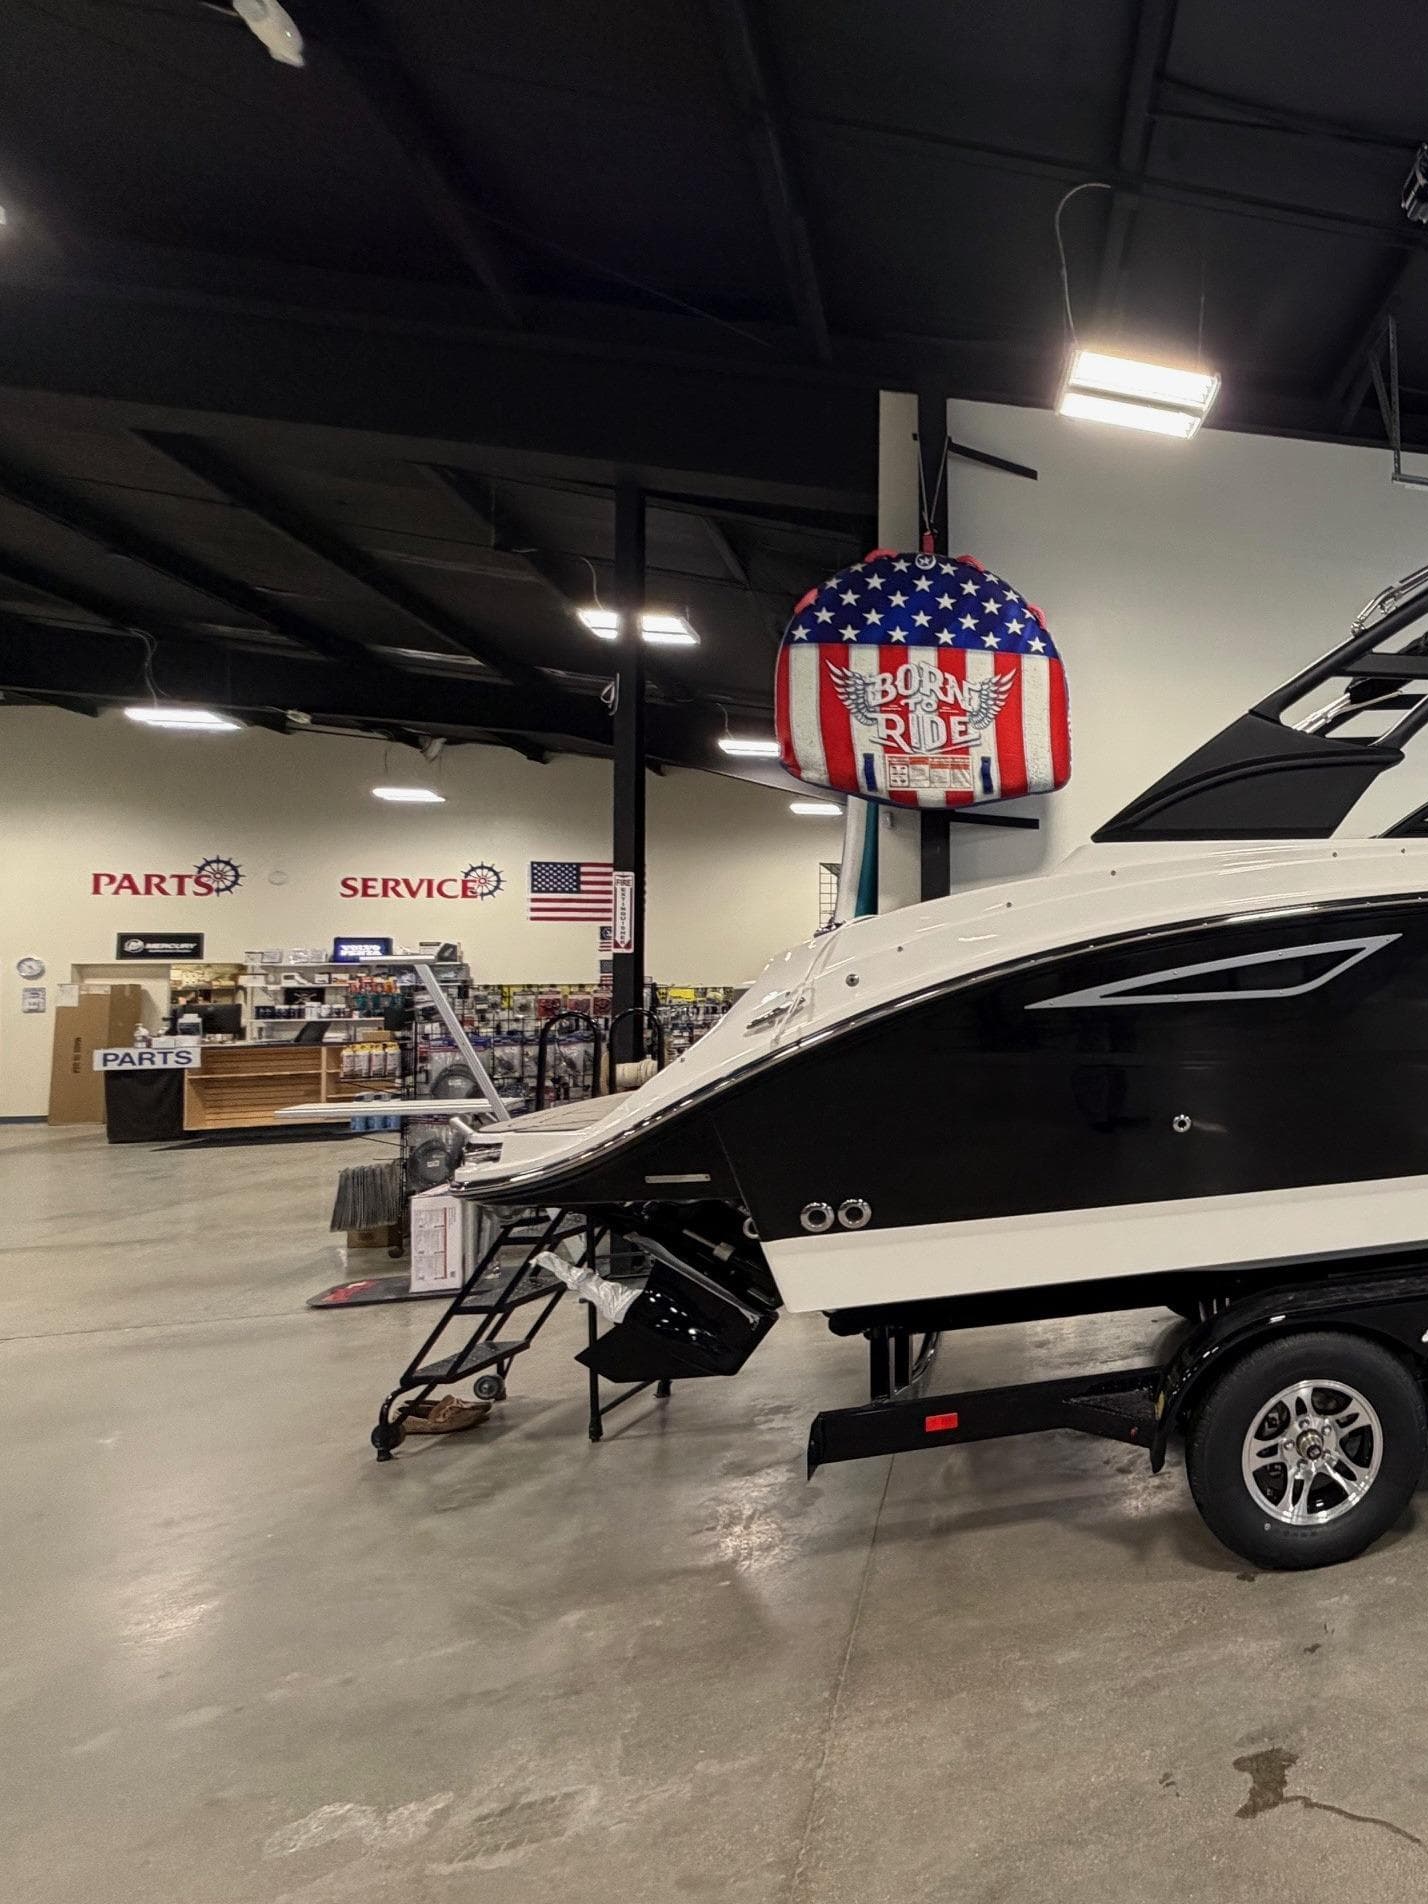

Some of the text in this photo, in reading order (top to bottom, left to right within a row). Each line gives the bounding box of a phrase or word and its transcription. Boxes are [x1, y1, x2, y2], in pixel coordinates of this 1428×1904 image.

[865, 661, 983, 713] BORN
[900, 697, 938, 712] TO
[865, 712, 981, 753] RIDE
[91, 873, 215, 897] PARTS
[339, 877, 478, 899] SERVICE
[619, 887, 627, 945] EXTINGUISHER
[102, 1050, 193, 1067] PARTS
